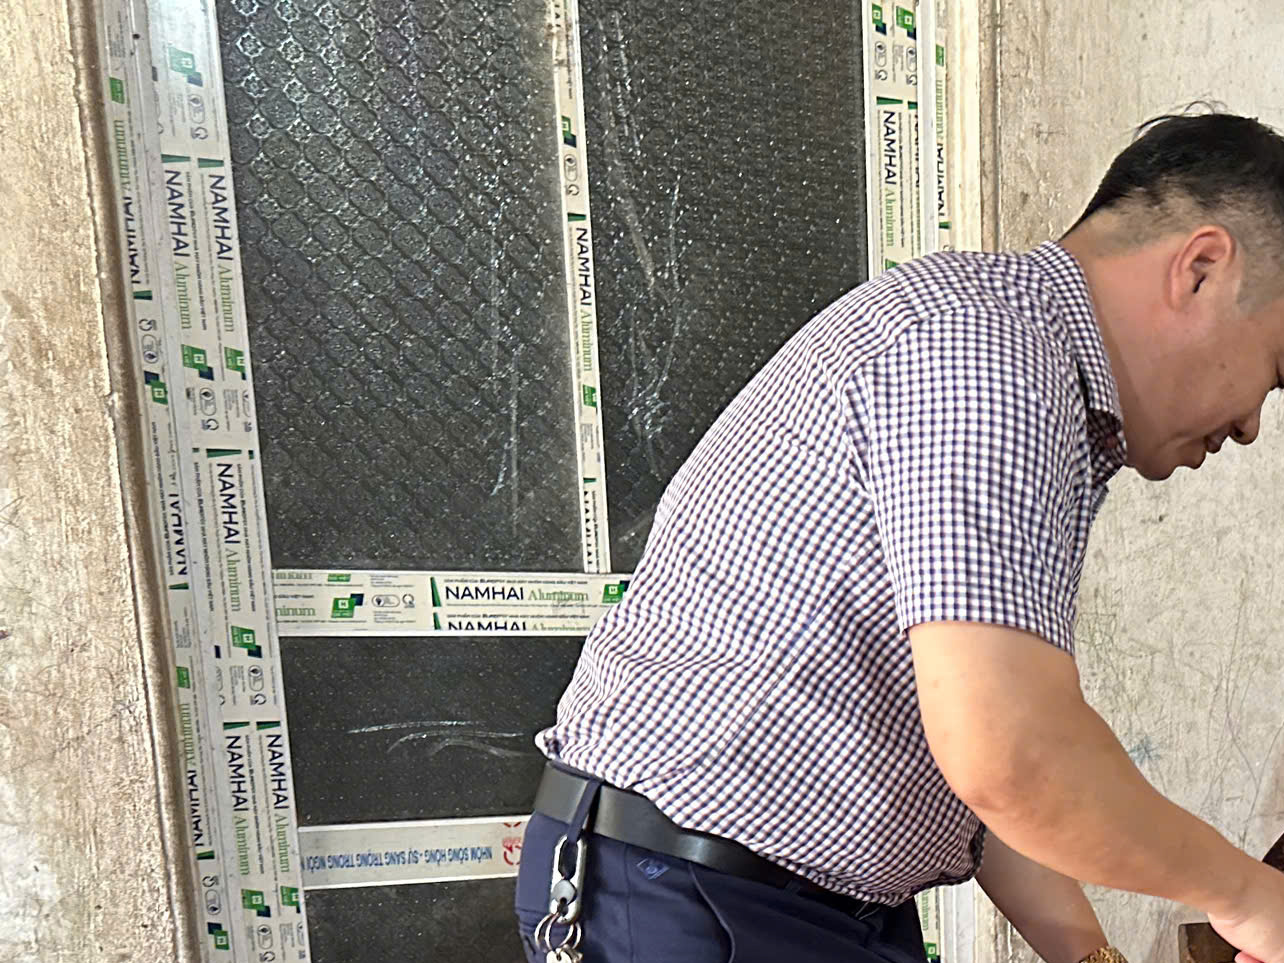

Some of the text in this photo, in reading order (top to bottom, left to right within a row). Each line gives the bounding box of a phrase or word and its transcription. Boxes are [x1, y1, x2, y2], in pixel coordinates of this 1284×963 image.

[883, 110, 897, 247] NAMHAI Aluminum
[165, 170, 192, 330] NAMHAI Aluminum
[208, 174, 235, 332] NAMHAI Aluminum
[576, 228, 593, 372] NAMHAI Aluminum
[217, 463, 242, 612] NAMHAI Aluminum
[445, 586, 524, 601] NAMHAI
[225, 736, 250, 876] NAMHAI Aluminum
[266, 735, 290, 873] NAMHAI Aluminum
[384, 850, 406, 866] SANG
[448, 847, 469, 863] SÔNG
[471, 846, 493, 863] NHÔM
